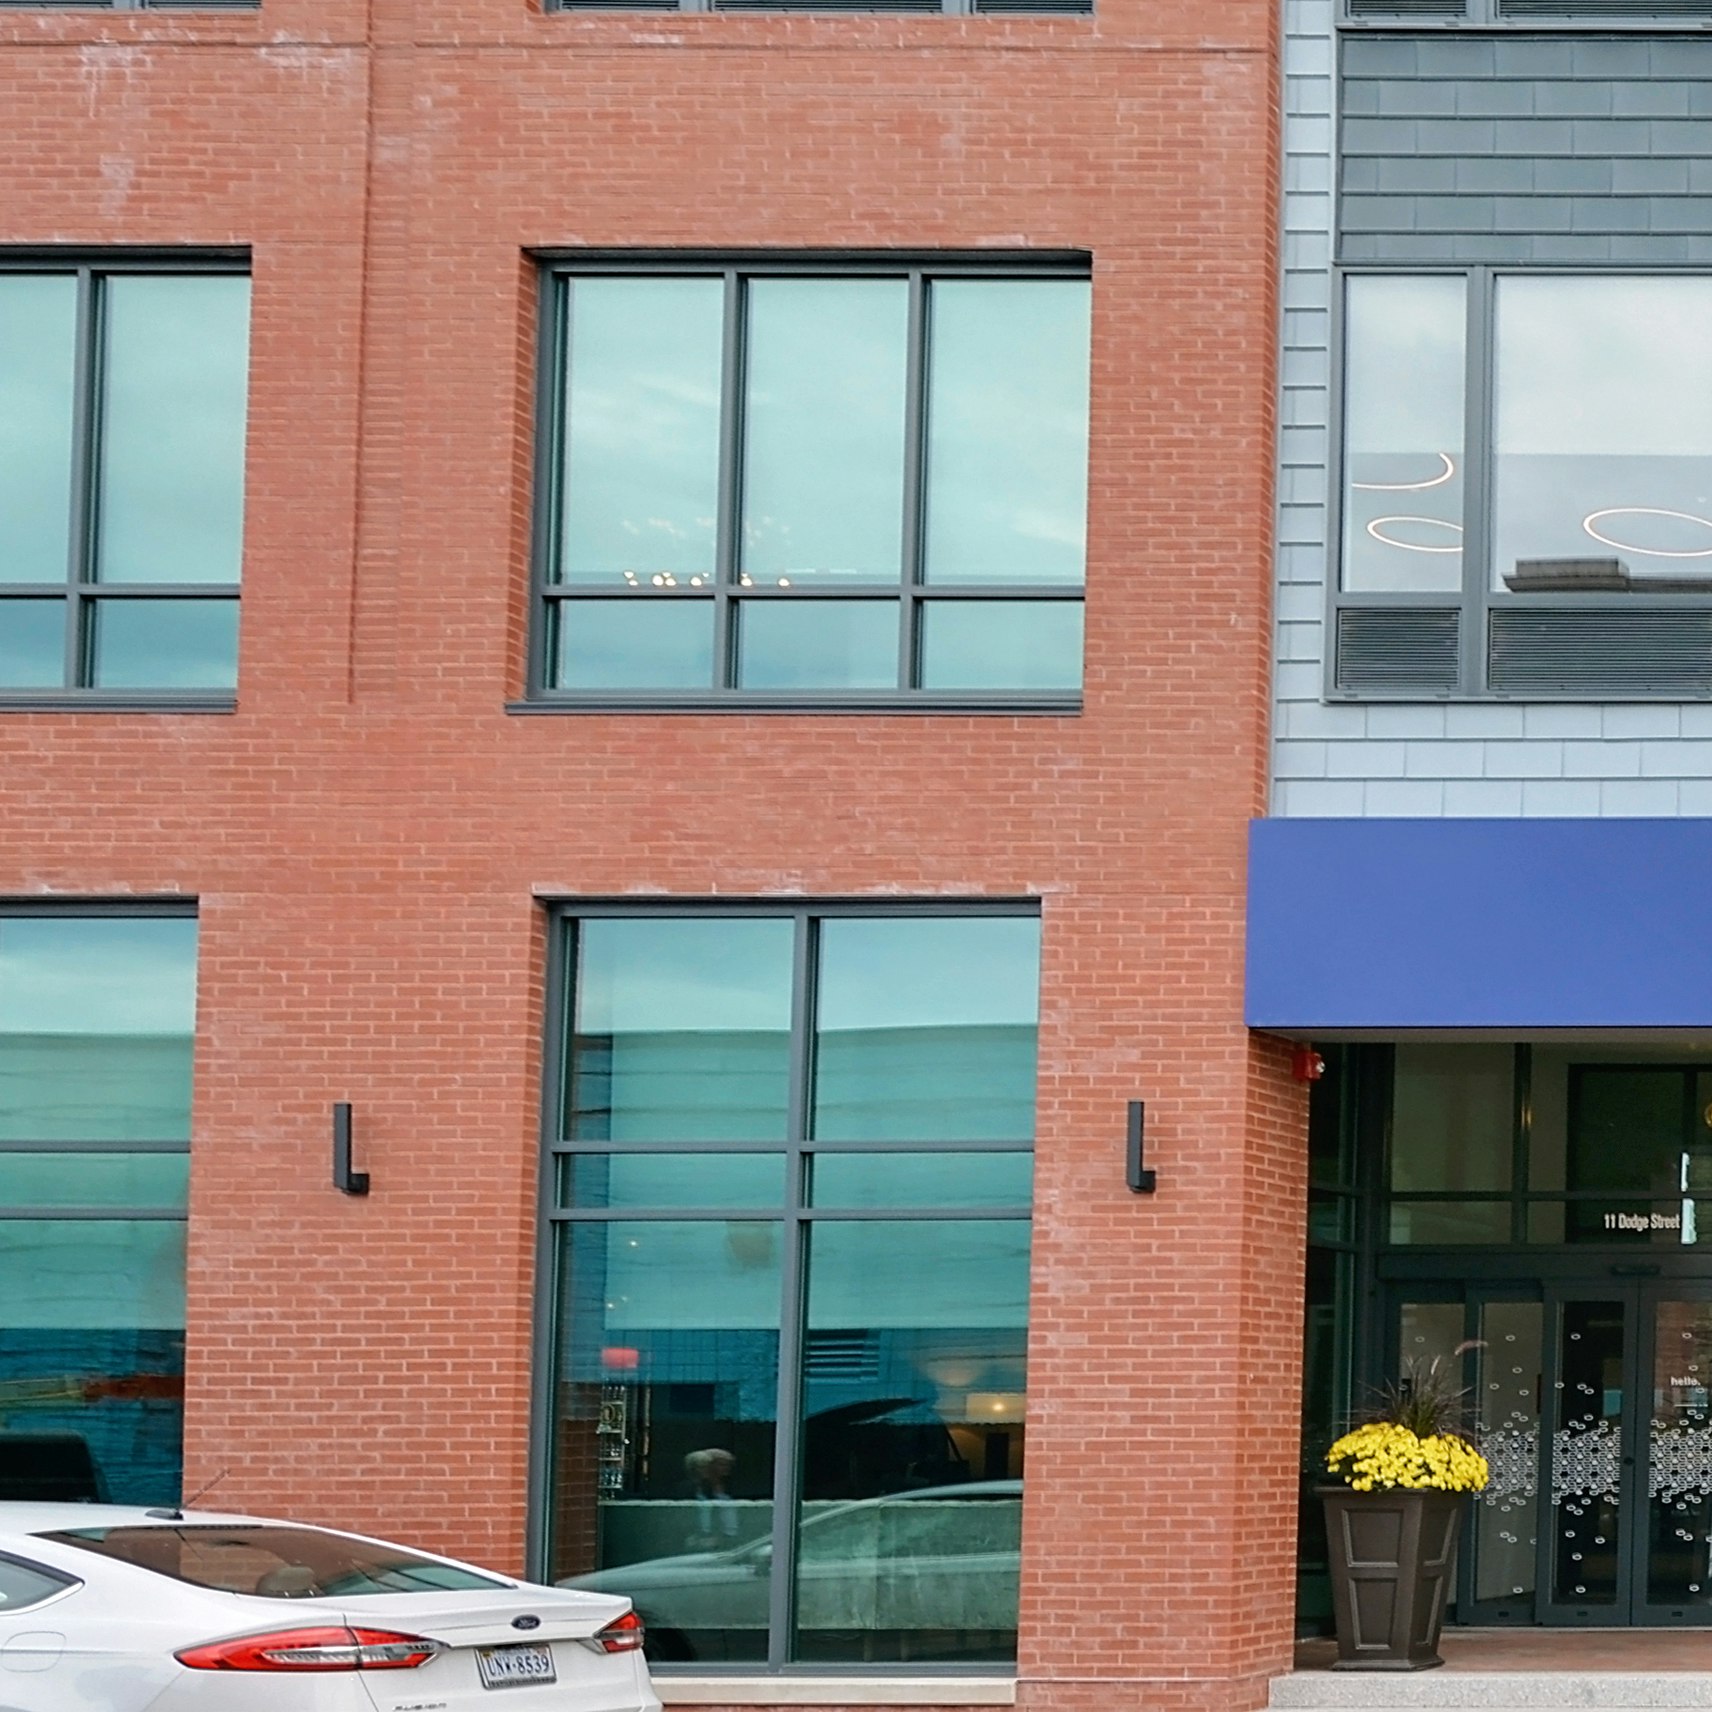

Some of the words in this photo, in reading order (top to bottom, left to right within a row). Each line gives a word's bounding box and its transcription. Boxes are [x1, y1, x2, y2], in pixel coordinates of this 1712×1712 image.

[1604, 1213, 1616, 1229] 11
[1618, 1213, 1649, 1232] Dodge
[1650, 1213, 1680, 1229] Street
[1670, 1375, 1701, 1386] hello.
